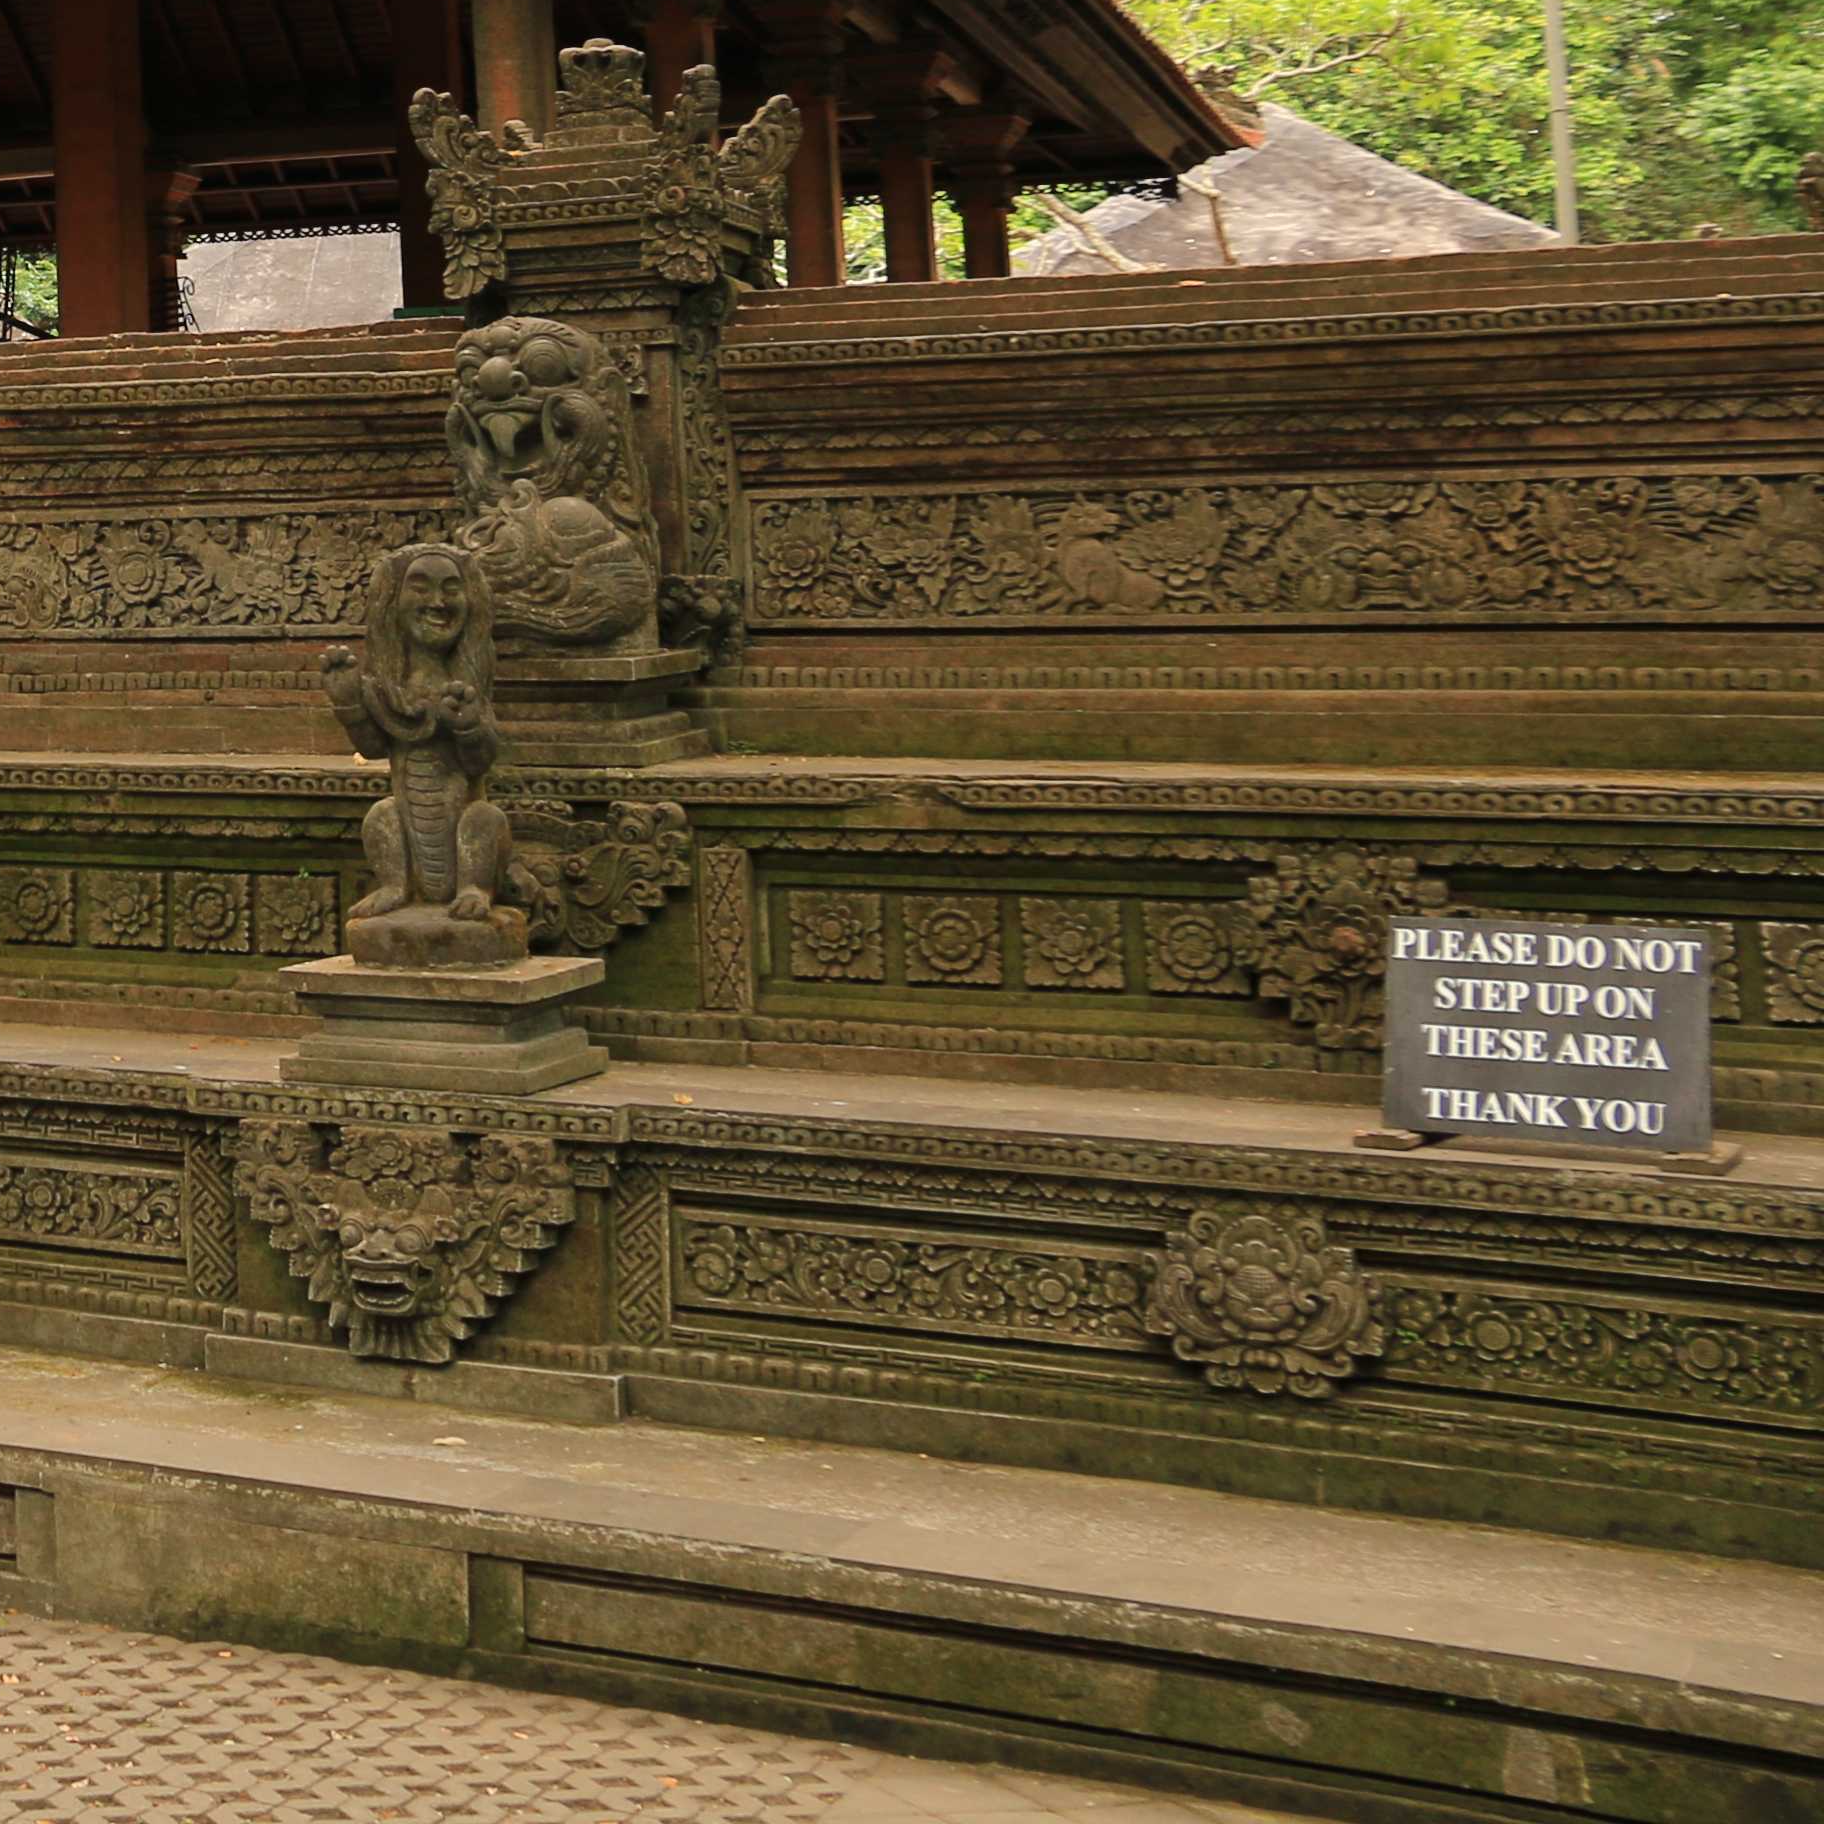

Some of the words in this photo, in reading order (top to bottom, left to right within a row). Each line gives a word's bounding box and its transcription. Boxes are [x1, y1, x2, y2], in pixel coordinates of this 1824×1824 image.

[1391, 927, 1538, 966] PLEASE
[1544, 934, 1607, 969] DO
[1610, 937, 1702, 974] NOT
[1433, 976, 1530, 1013] STEP
[1535, 982, 1590, 1017] UP
[1592, 986, 1656, 1021] ON
[1420, 1023, 1549, 1064] THESE
[1552, 1033, 1670, 1071] AREA
[1421, 1087, 1569, 1128] THANK
[1572, 1097, 1667, 1136] YOU
